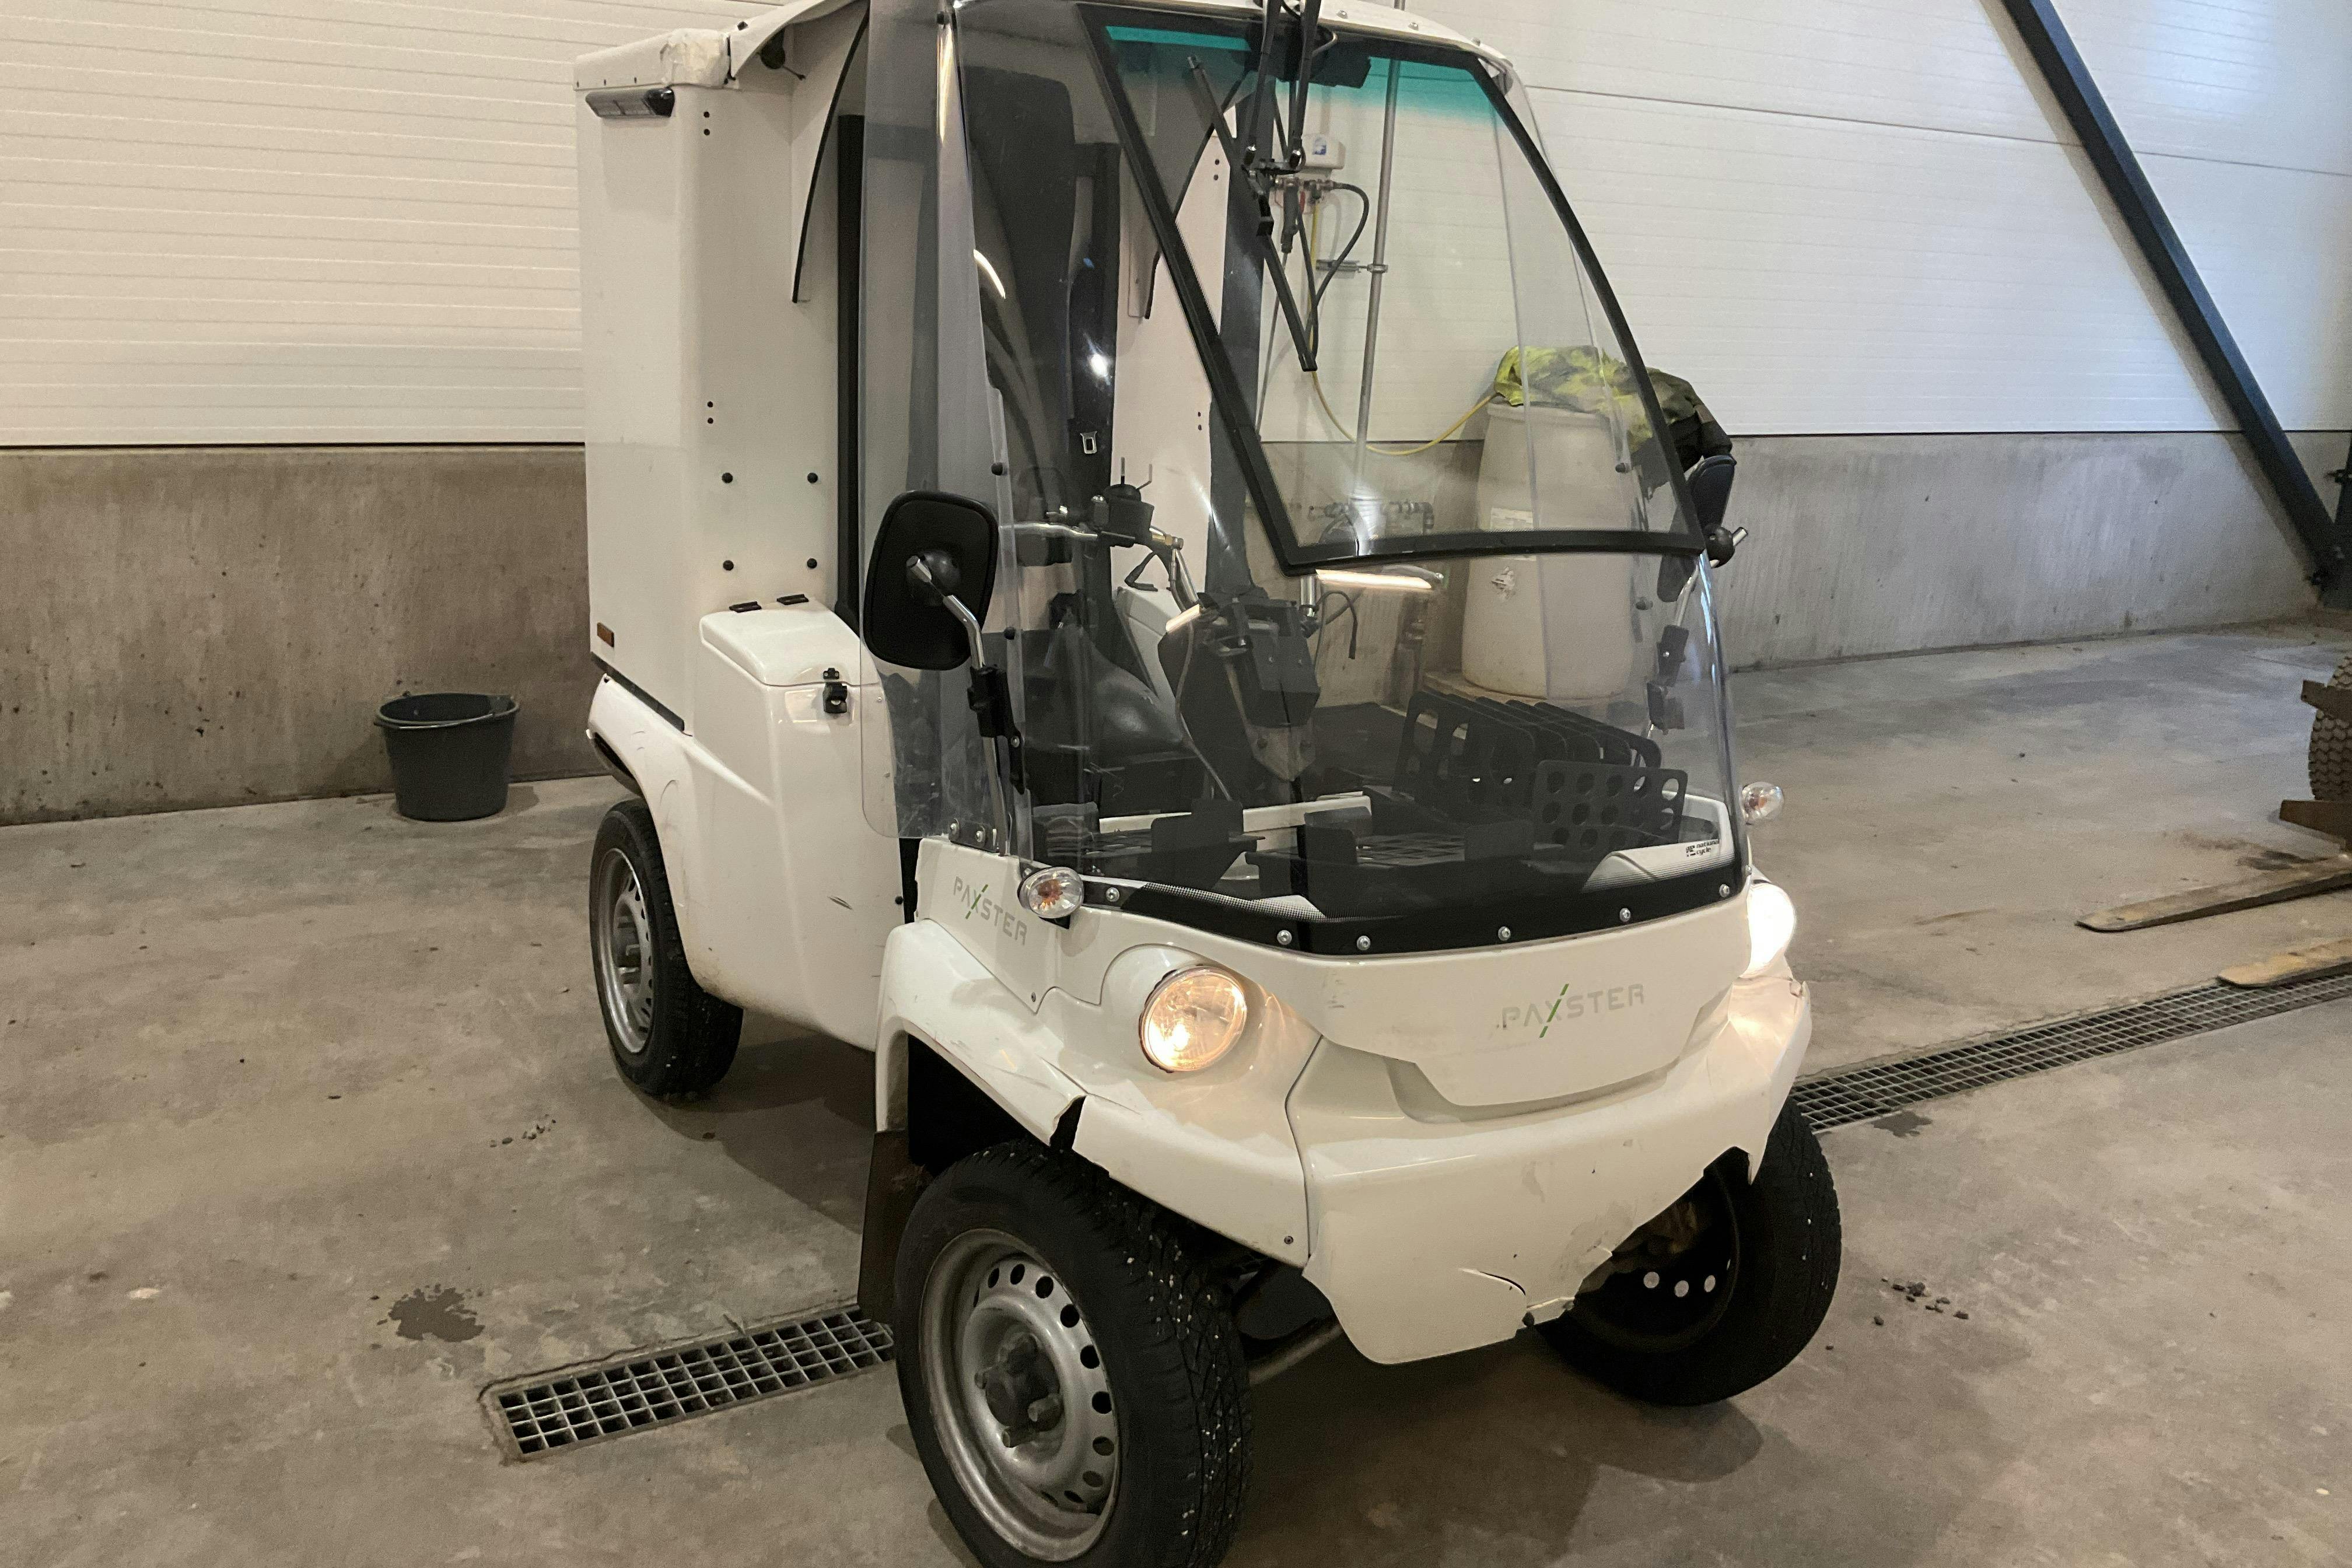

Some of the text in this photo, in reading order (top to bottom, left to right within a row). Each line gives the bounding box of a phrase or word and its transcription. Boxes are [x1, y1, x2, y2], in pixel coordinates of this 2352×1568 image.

[1696, 847, 1712, 856] cycle
[953, 876, 1027, 946] PAXSTER
[1502, 983, 1644, 1038] PAXSTER
